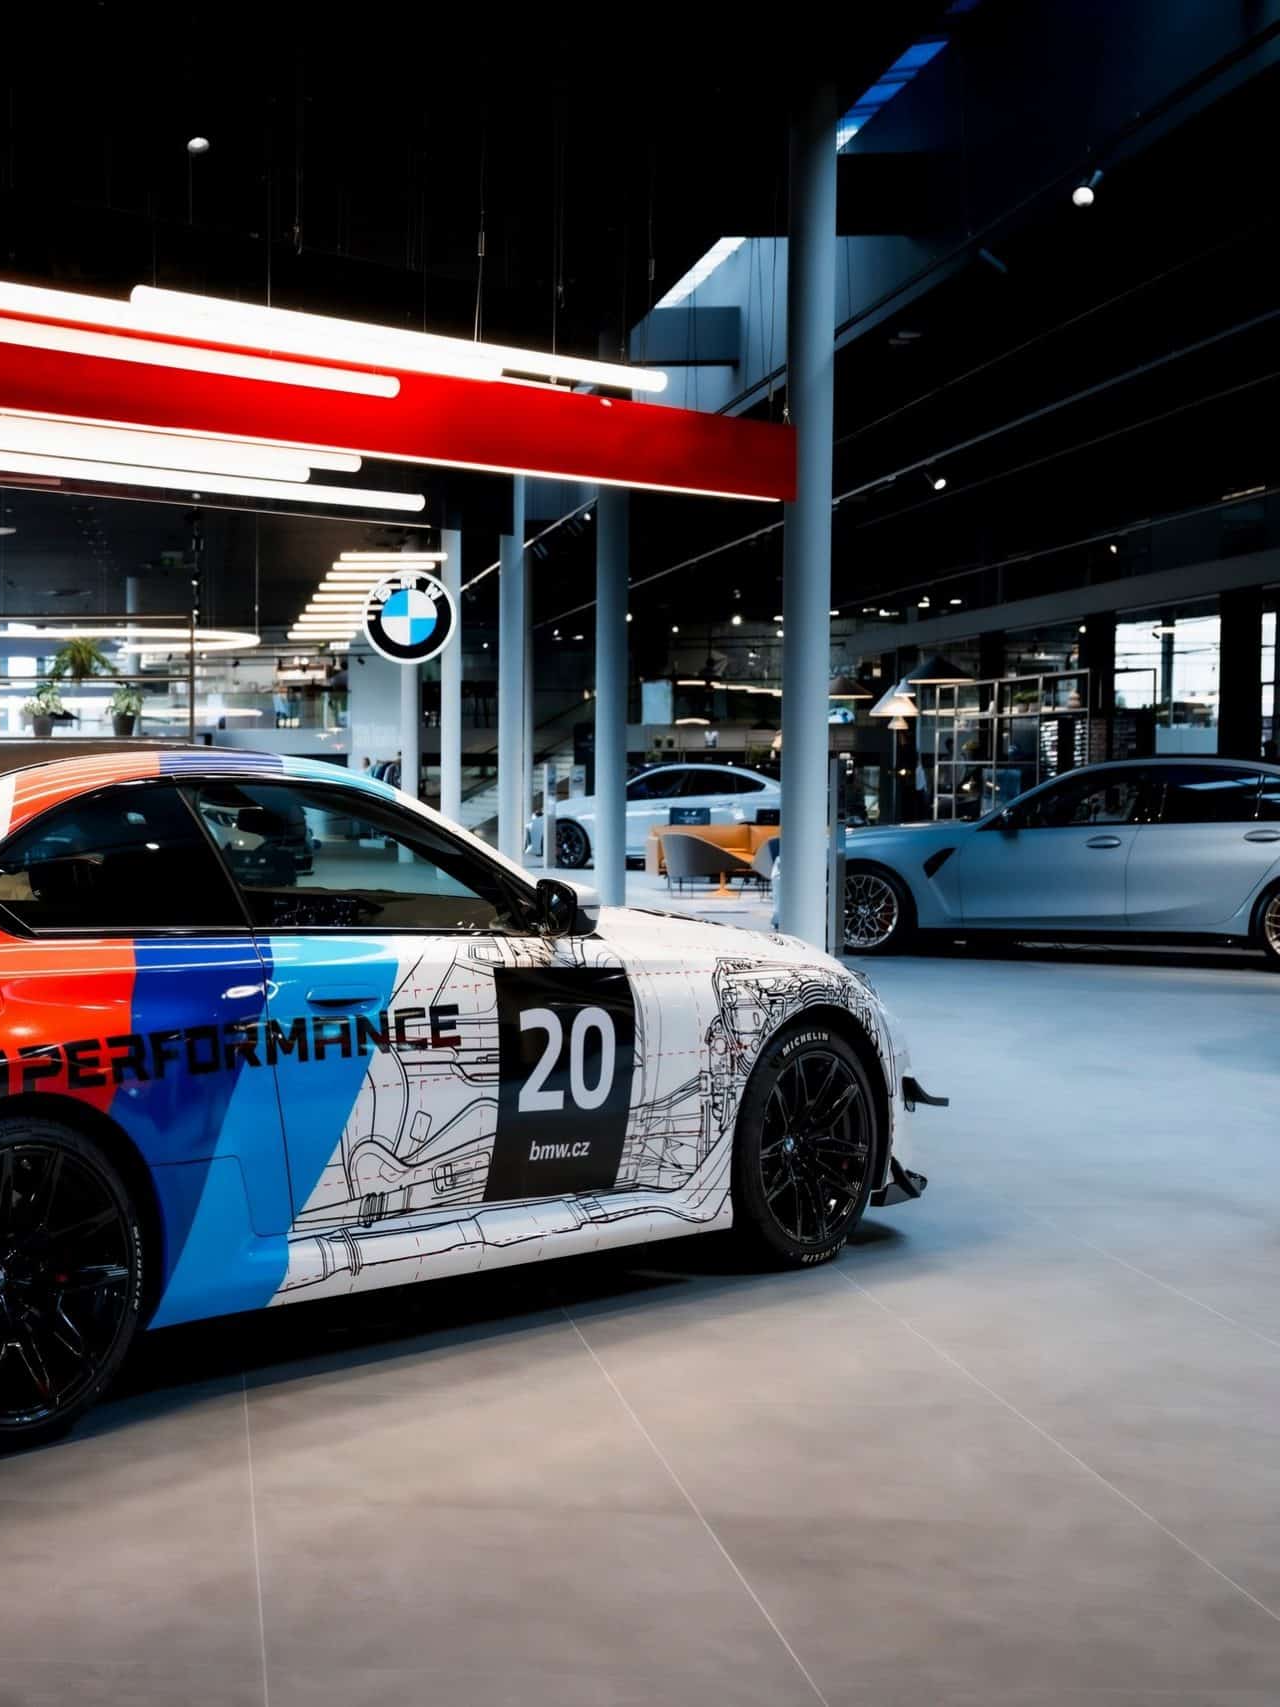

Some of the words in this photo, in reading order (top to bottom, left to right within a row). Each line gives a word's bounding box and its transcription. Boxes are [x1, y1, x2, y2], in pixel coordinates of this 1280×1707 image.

[782, 1031, 829, 1057] MICHELIN
[518, 1007, 616, 1112] 20
[529, 1140, 592, 1161] bmw.cz
